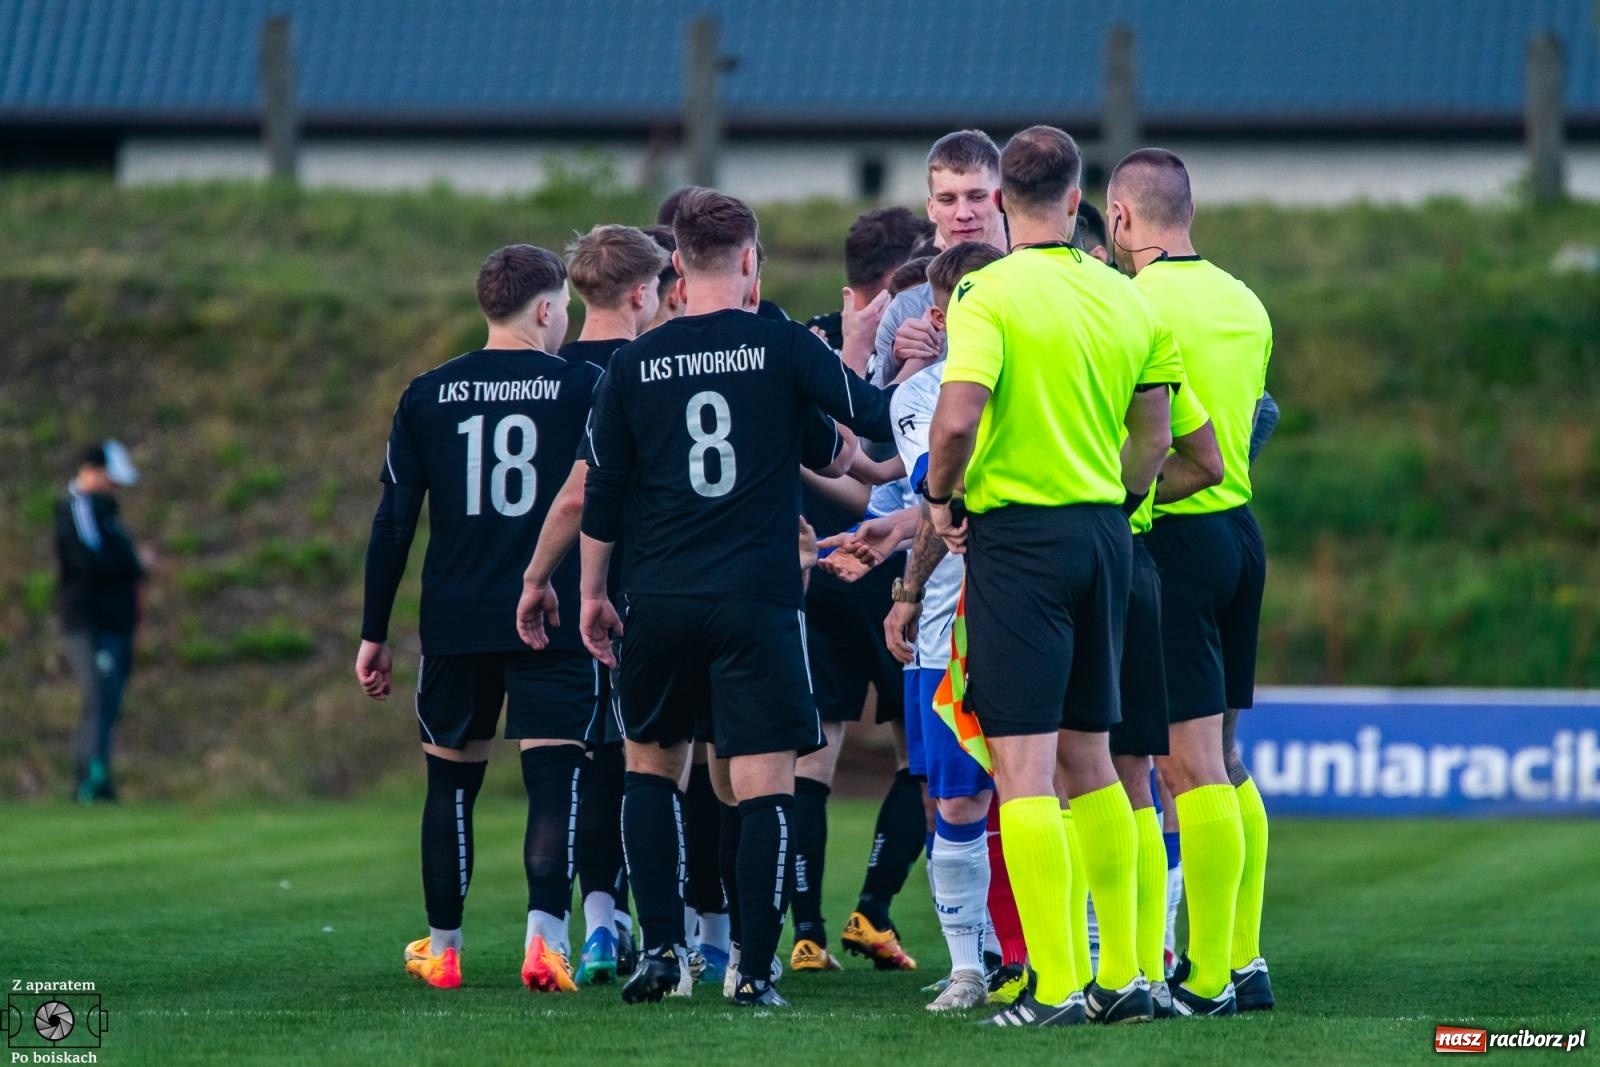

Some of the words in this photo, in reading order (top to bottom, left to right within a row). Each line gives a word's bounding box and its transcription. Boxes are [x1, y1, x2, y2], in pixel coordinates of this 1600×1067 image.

[438, 381, 470, 404] LKS
[473, 376, 561, 402] TWORKÓW
[640, 353, 673, 383] LKS
[674, 344, 766, 377] TWORKÓW
[457, 413, 538, 517] 18
[685, 390, 737, 498] 8
